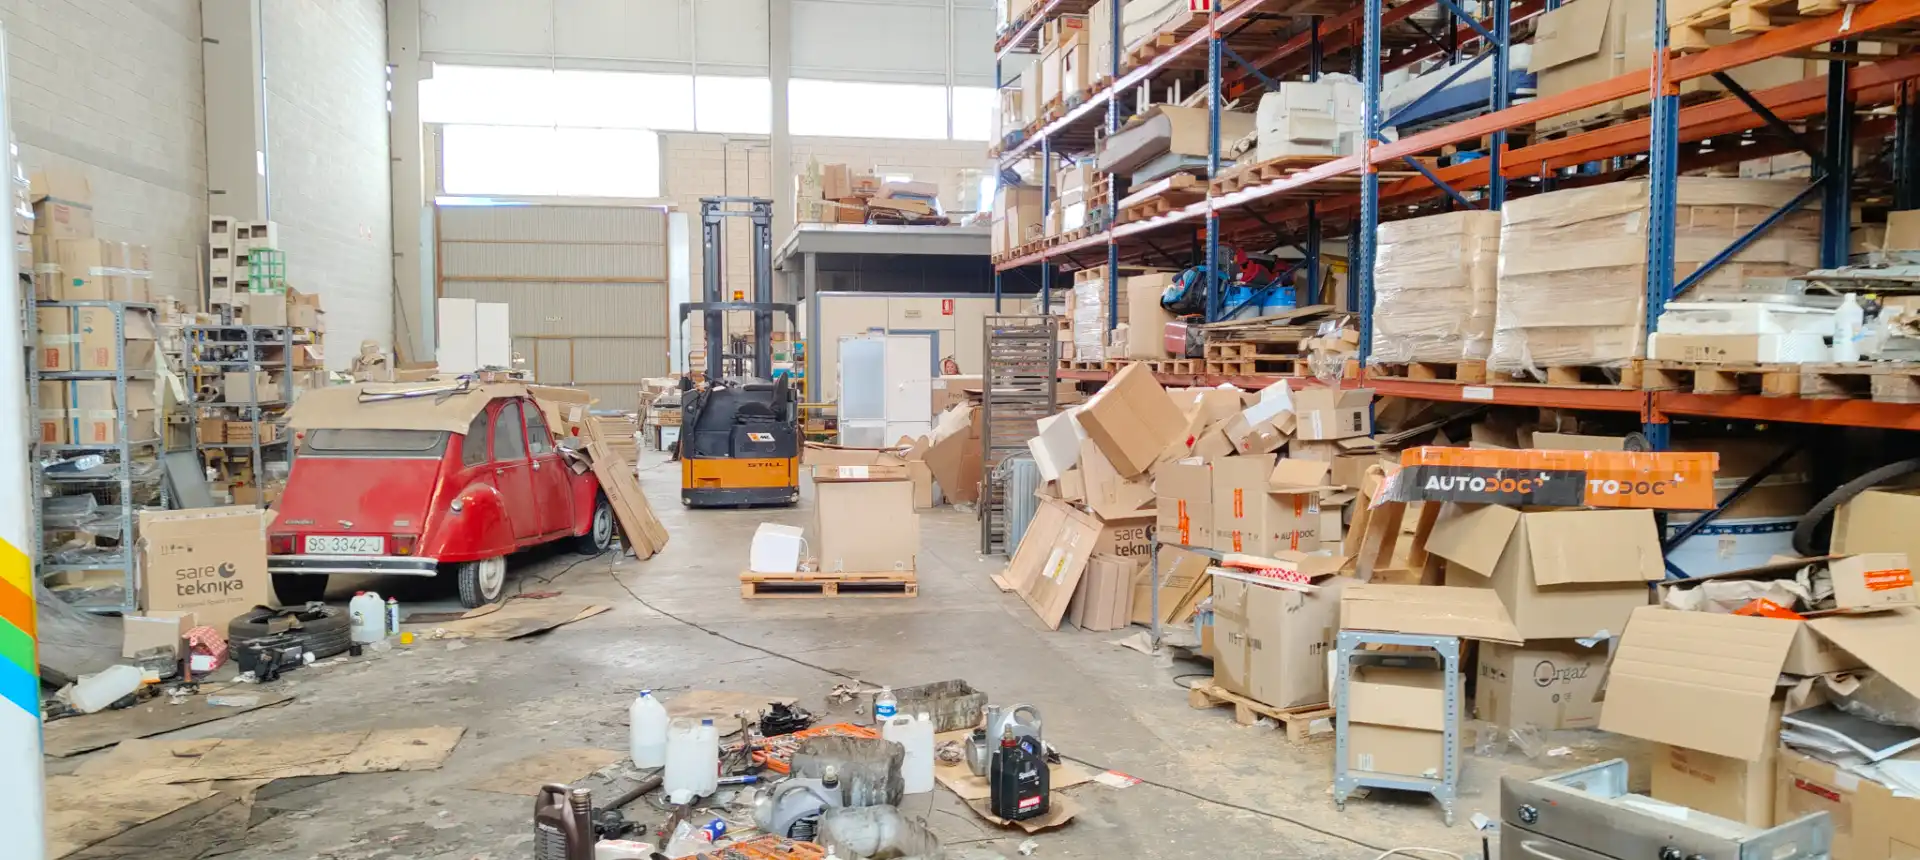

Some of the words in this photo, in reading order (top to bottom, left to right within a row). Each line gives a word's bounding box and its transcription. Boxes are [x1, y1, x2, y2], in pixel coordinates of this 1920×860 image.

[1424, 474, 1532, 494] AUTODOC
[1114, 528, 1144, 541] sare
[1115, 541, 1152, 559] tekni
[176, 565, 216, 580] sare
[177, 579, 244, 596] teknika
[1533, 660, 1588, 688] Orgaz
